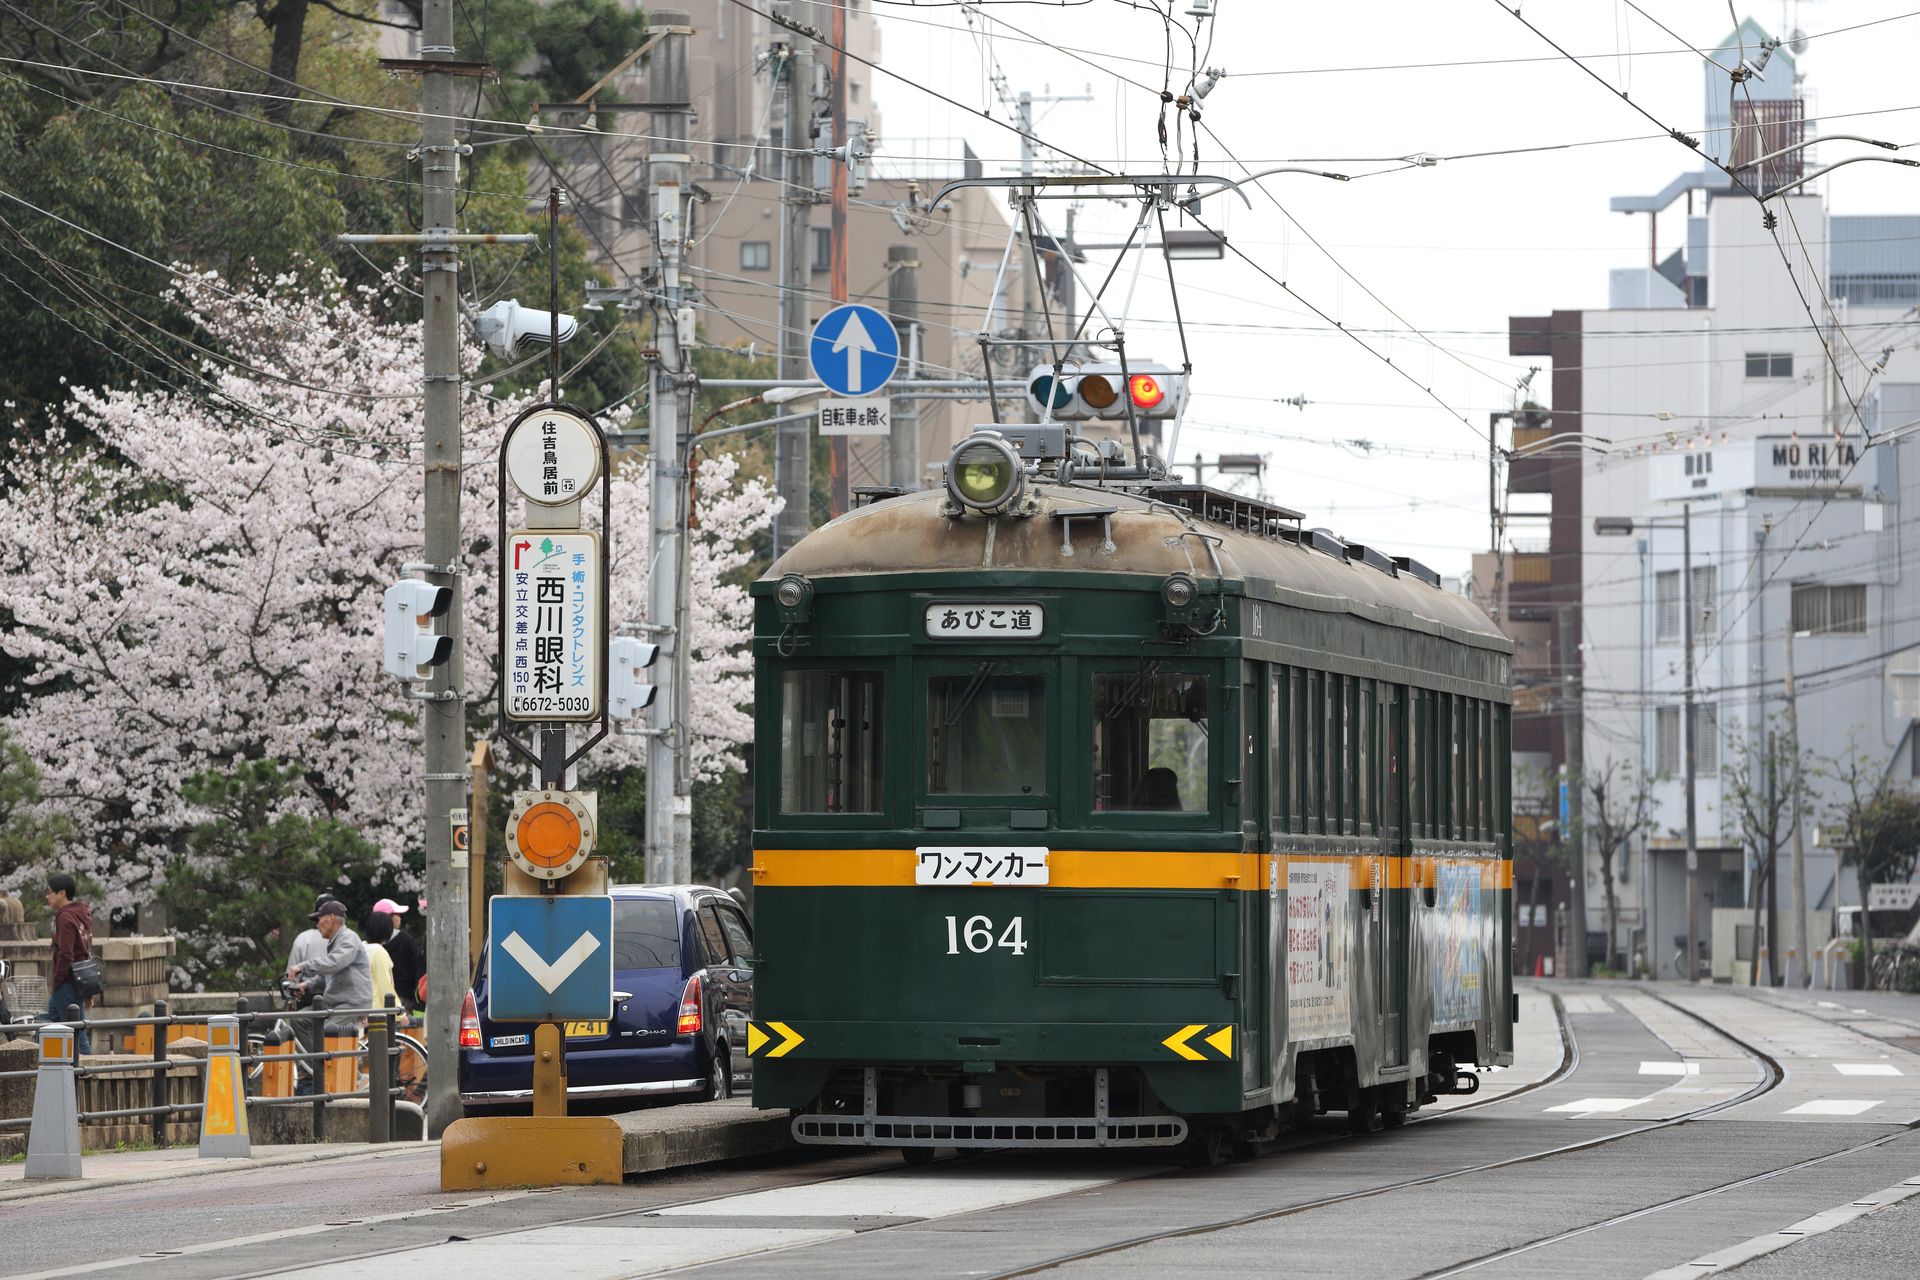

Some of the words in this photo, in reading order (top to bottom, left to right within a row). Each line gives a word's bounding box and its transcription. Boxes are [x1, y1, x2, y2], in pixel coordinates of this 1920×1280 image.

[822, 407, 887, 426] 自転車を除く
[541, 421, 558, 495] 住吉鳥居前
[1790, 469, 1841, 480] BOUTIQUE
[571, 553, 586, 687] 手術・コンタクトレンズ
[940, 608, 1033, 631] あびこ道
[1252, 604, 1263, 637] 164
[533, 576, 566, 695] 西川眼科
[522, 697, 590, 711] 6672-5030
[920, 852, 1044, 879] ワンマンカー
[945, 915, 1028, 955] 164
[494, 1037, 509, 1046] CHILD
[515, 1036, 526, 1044] CAR
